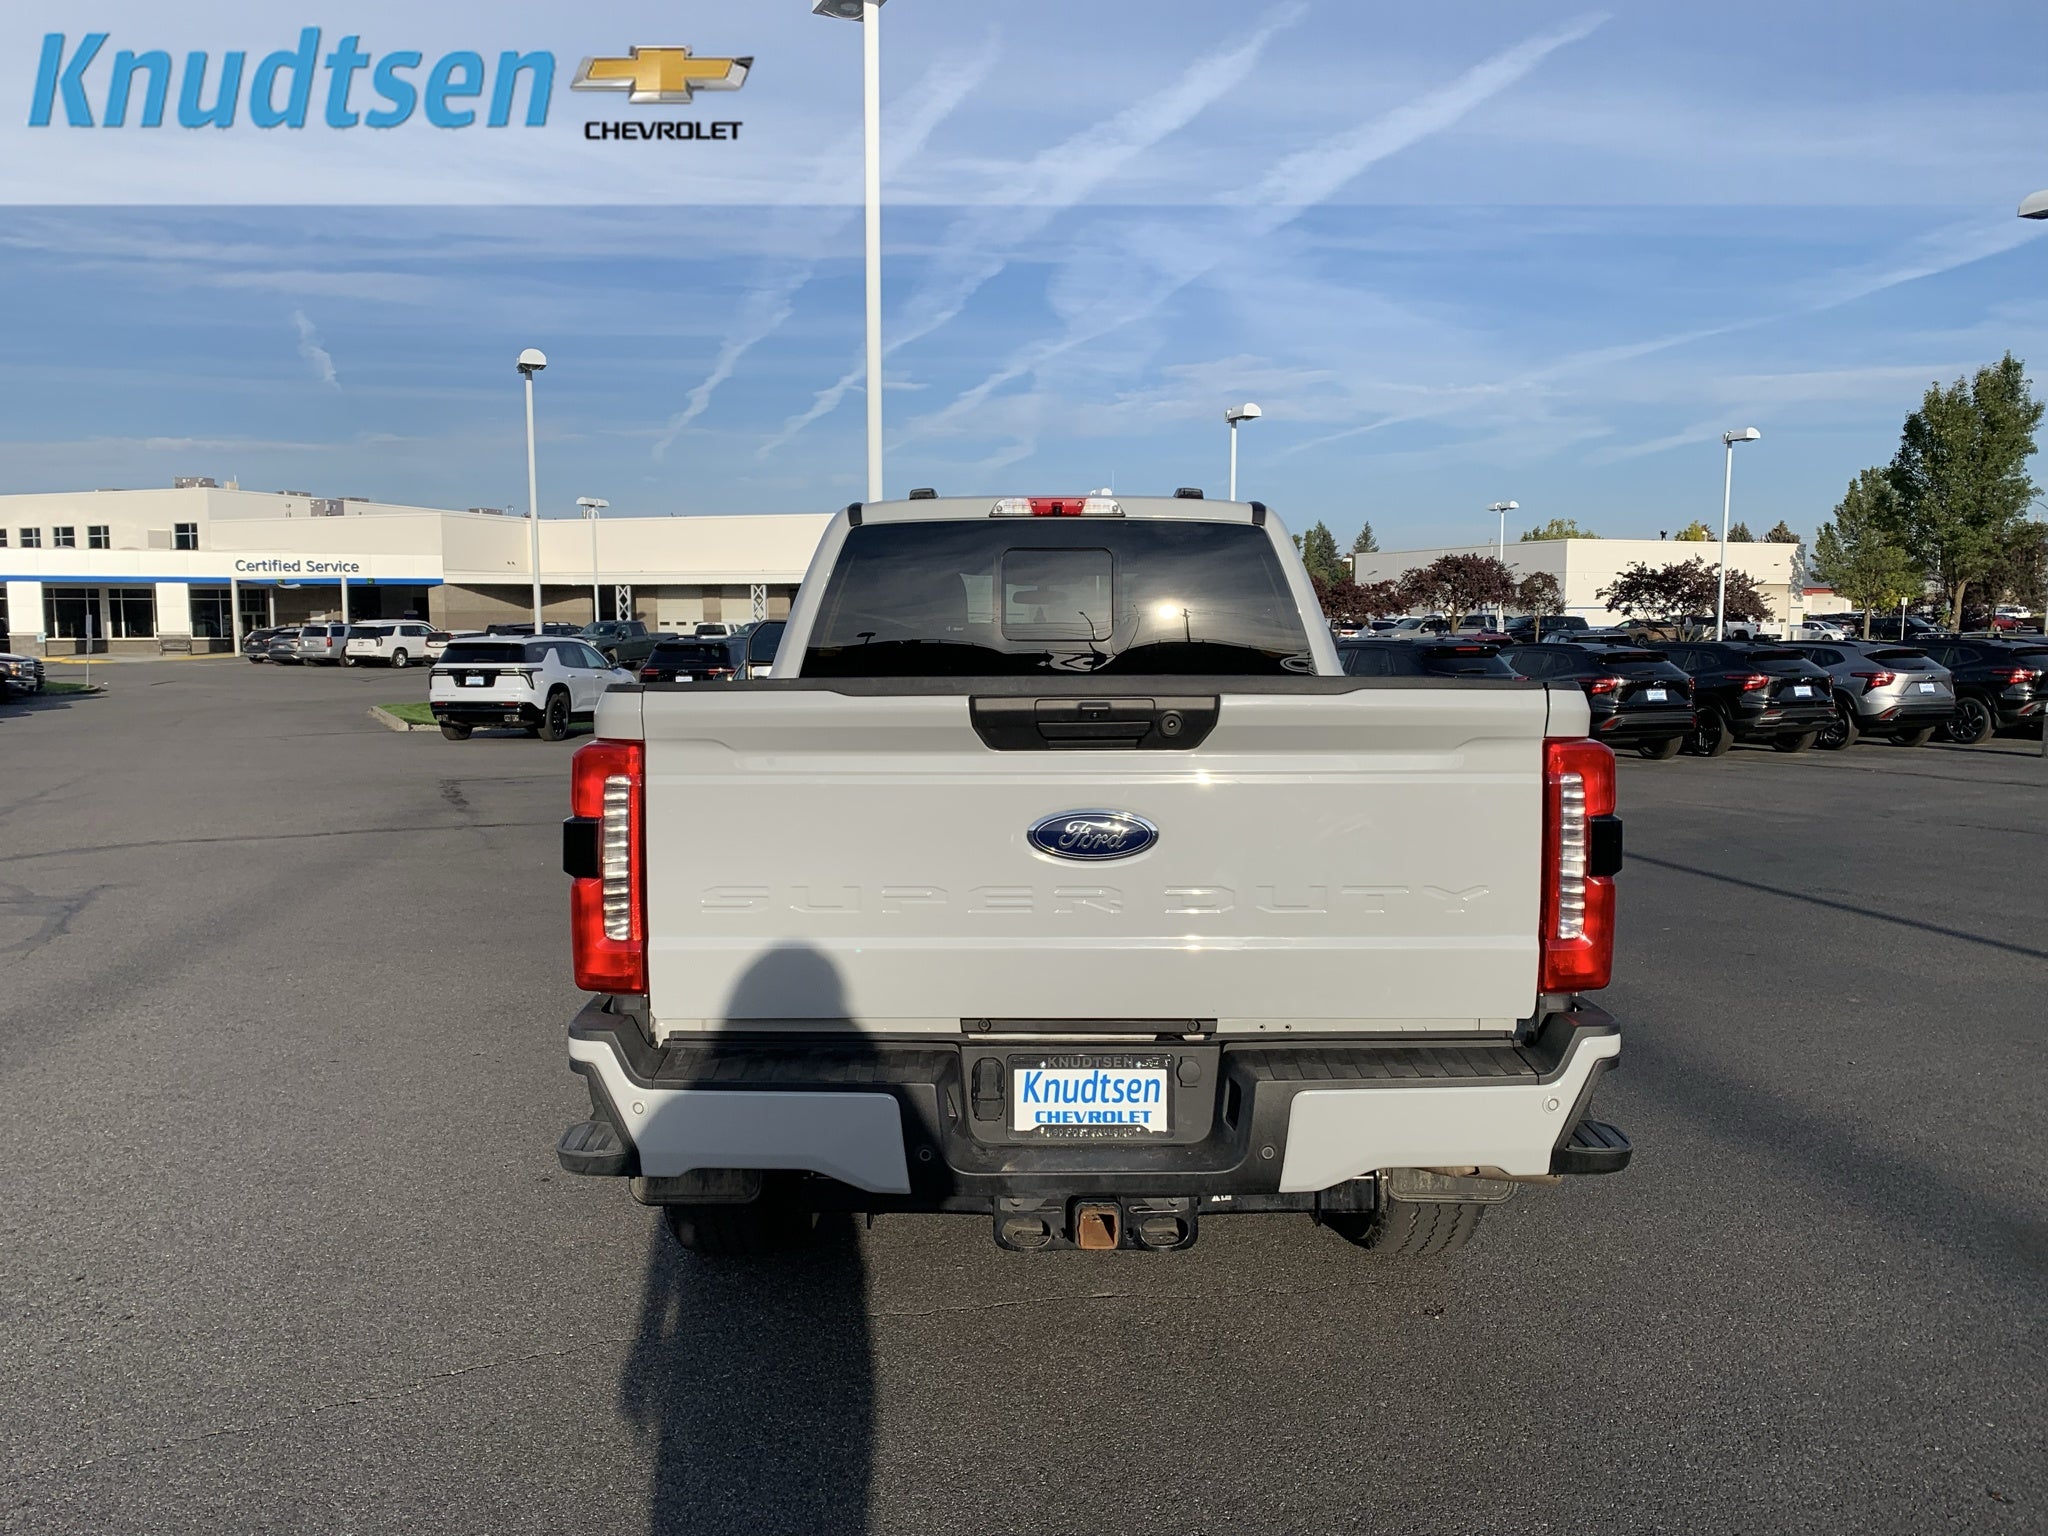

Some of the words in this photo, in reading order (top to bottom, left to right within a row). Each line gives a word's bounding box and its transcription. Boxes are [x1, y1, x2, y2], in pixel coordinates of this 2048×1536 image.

[235, 559, 300, 572] Certified
[306, 560, 360, 573] Service
[1058, 820, 1130, 849] Ford
[702, 885, 1123, 913] SUPER
[1164, 885, 1489, 913] DUTY
[1047, 1057, 1133, 1068] KNUDTSEN
[1023, 1070, 1161, 1103] Knudtsen
[1035, 1111, 1152, 1123] CHEVROLET
